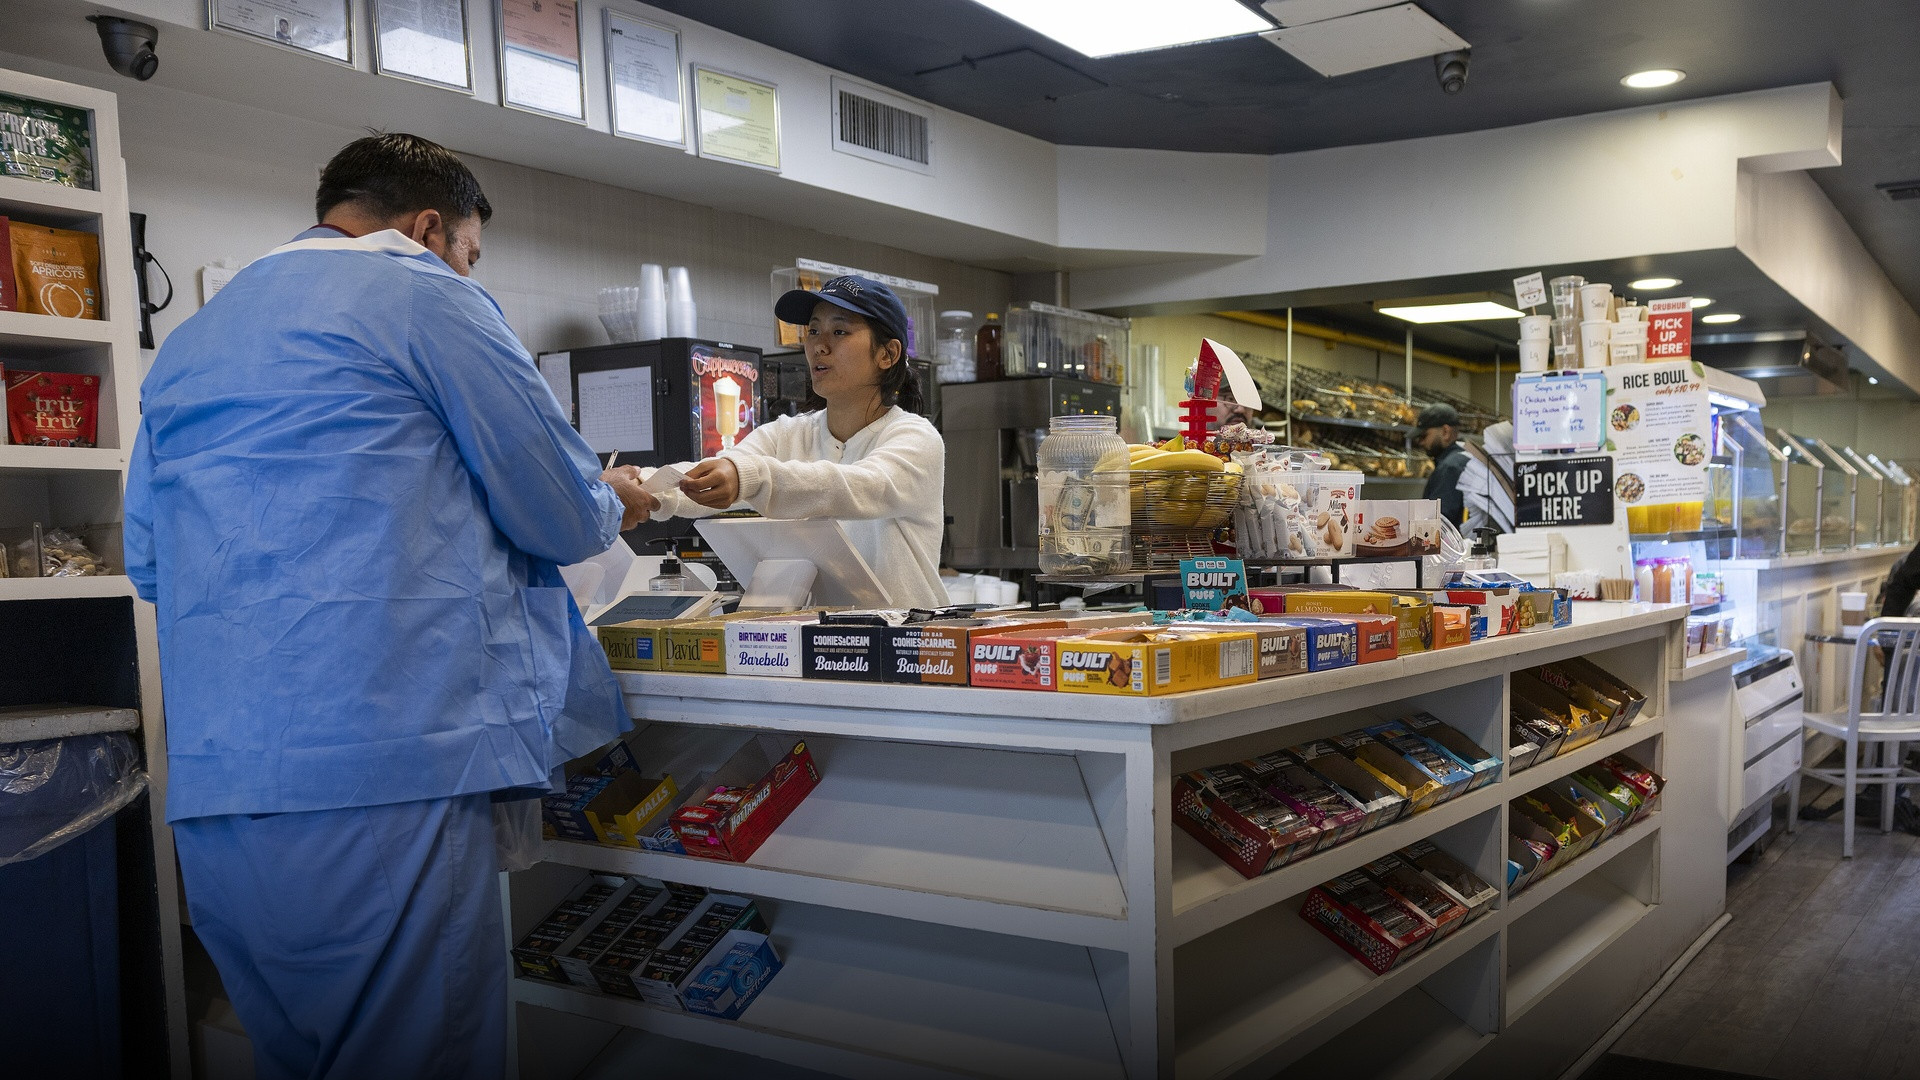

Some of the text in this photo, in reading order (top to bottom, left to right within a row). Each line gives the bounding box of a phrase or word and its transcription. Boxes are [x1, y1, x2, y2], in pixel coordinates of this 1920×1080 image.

[31, 265, 85, 279] APRICOTS
[1652, 302, 1687, 311] GRUBHUB
[1653, 317, 1684, 331] PICK
[1659, 330, 1677, 343] UP
[1651, 342, 1684, 356] HERE
[692, 351, 759, 382] Cappuccino
[1622, 369, 1690, 390] RICE BOWL
[1655, 385, 1673, 397] only
[35, 396, 77, 413] trü
[1524, 395, 1547, 404] Chicken
[35, 411, 77, 429] frü
[1517, 462, 1538, 478] Please
[1523, 469, 1603, 497] PICK UP
[1541, 496, 1583, 521] HERE
[1187, 572, 1238, 588] BUILT
[1189, 590, 1215, 600] PUFF
[1295, 605, 1333, 613] ALMONDS
[738, 632, 787, 642] BIRTHDAY CAKE
[1261, 635, 1290, 653] BUILT
[1316, 633, 1342, 649] BUILT
[602, 636, 635, 659] David
[665, 637, 700, 661] David
[973, 644, 1021, 662] BUILT
[1040, 645, 1049, 654] 12
[738, 651, 789, 667] Barebells
[814, 655, 869, 672] Barebells
[1061, 651, 1111, 669] BUILT
[1261, 655, 1277, 667] PUFF
[1317, 651, 1331, 662] PUFF
[896, 657, 954, 675] Barebells
[974, 663, 998, 675] PUFF
[1063, 672, 1086, 683] PUFF
[1250, 758, 1276, 775] KIND
[636, 786, 669, 822] HALLS
[728, 781, 771, 837] HOT TAMALES
[1190, 802, 1209, 820] KIND
[1332, 881, 1354, 895] KIND
[1319, 906, 1339, 924] KIND
[734, 966, 772, 1010] Winterfresh
